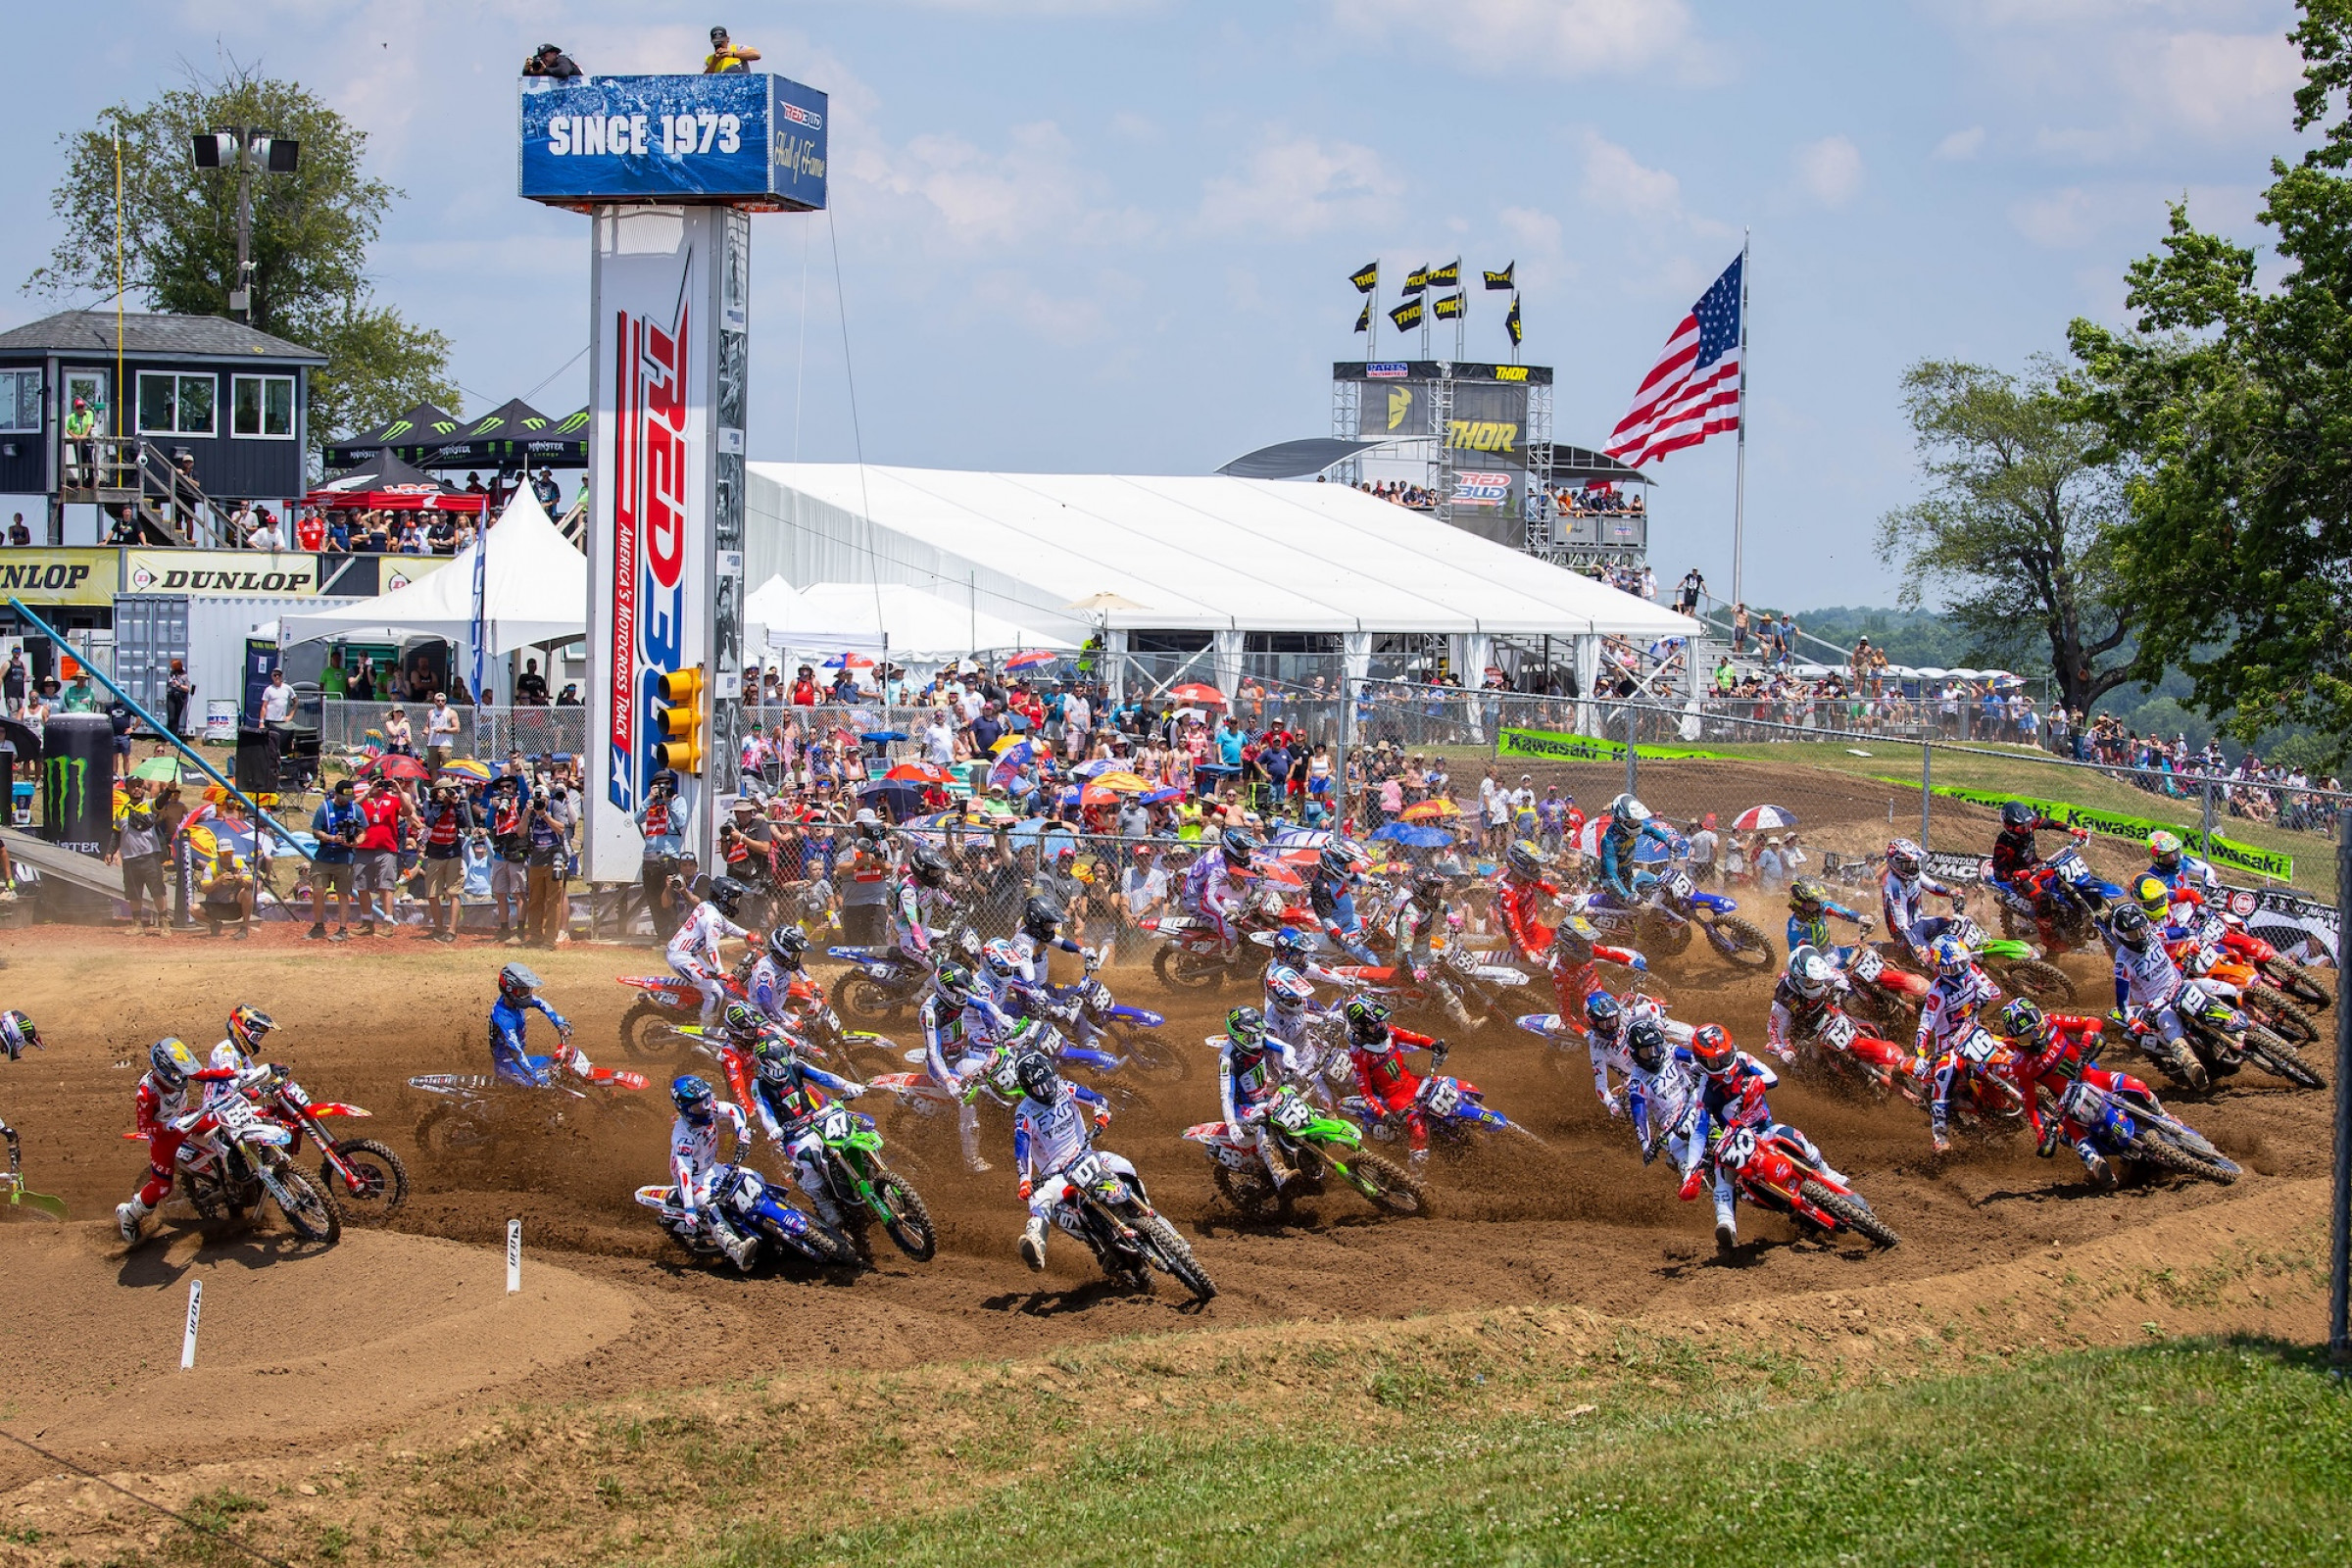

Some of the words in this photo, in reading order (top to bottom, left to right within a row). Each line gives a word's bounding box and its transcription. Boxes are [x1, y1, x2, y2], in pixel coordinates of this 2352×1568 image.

[548, 115, 649, 156] SINCE
[662, 113, 741, 155] 1973
[1353, 270, 1377, 287] THO
[1366, 363, 1408, 371] PARTS
[1494, 366, 1529, 381] THOR
[440, 445, 471, 455] MONSTER
[528, 441, 564, 452] MONSTER
[1444, 419, 1518, 453] THOR
[1459, 472, 1511, 486] RED
[0, 564, 89, 589] NLOP
[617, 521, 634, 603] AMERICA'S
[162, 570, 311, 592] DUNLOP
[614, 603, 632, 698] MOTOCROSS
[613, 698, 629, 740] TRACK
[1507, 733, 1597, 760] Kawasaki
[2066, 806, 2162, 841] Kawasa
[2059, 856, 2089, 883] 245
[2005, 892, 2032, 912] 245
[2185, 985, 2210, 1016] 19
[1824, 1018, 1856, 1050] 62
[1964, 1030, 1993, 1062] 16
[2140, 1035, 2158, 1052] 19
[1279, 1098, 1311, 1131] 56
[1430, 1082, 1458, 1117] 93
[825, 1108, 849, 1141] 47
[1217, 1148, 1243, 1169] 56
[1723, 1129, 1756, 1169] 30
[188, 1302, 200, 1337] UFO
